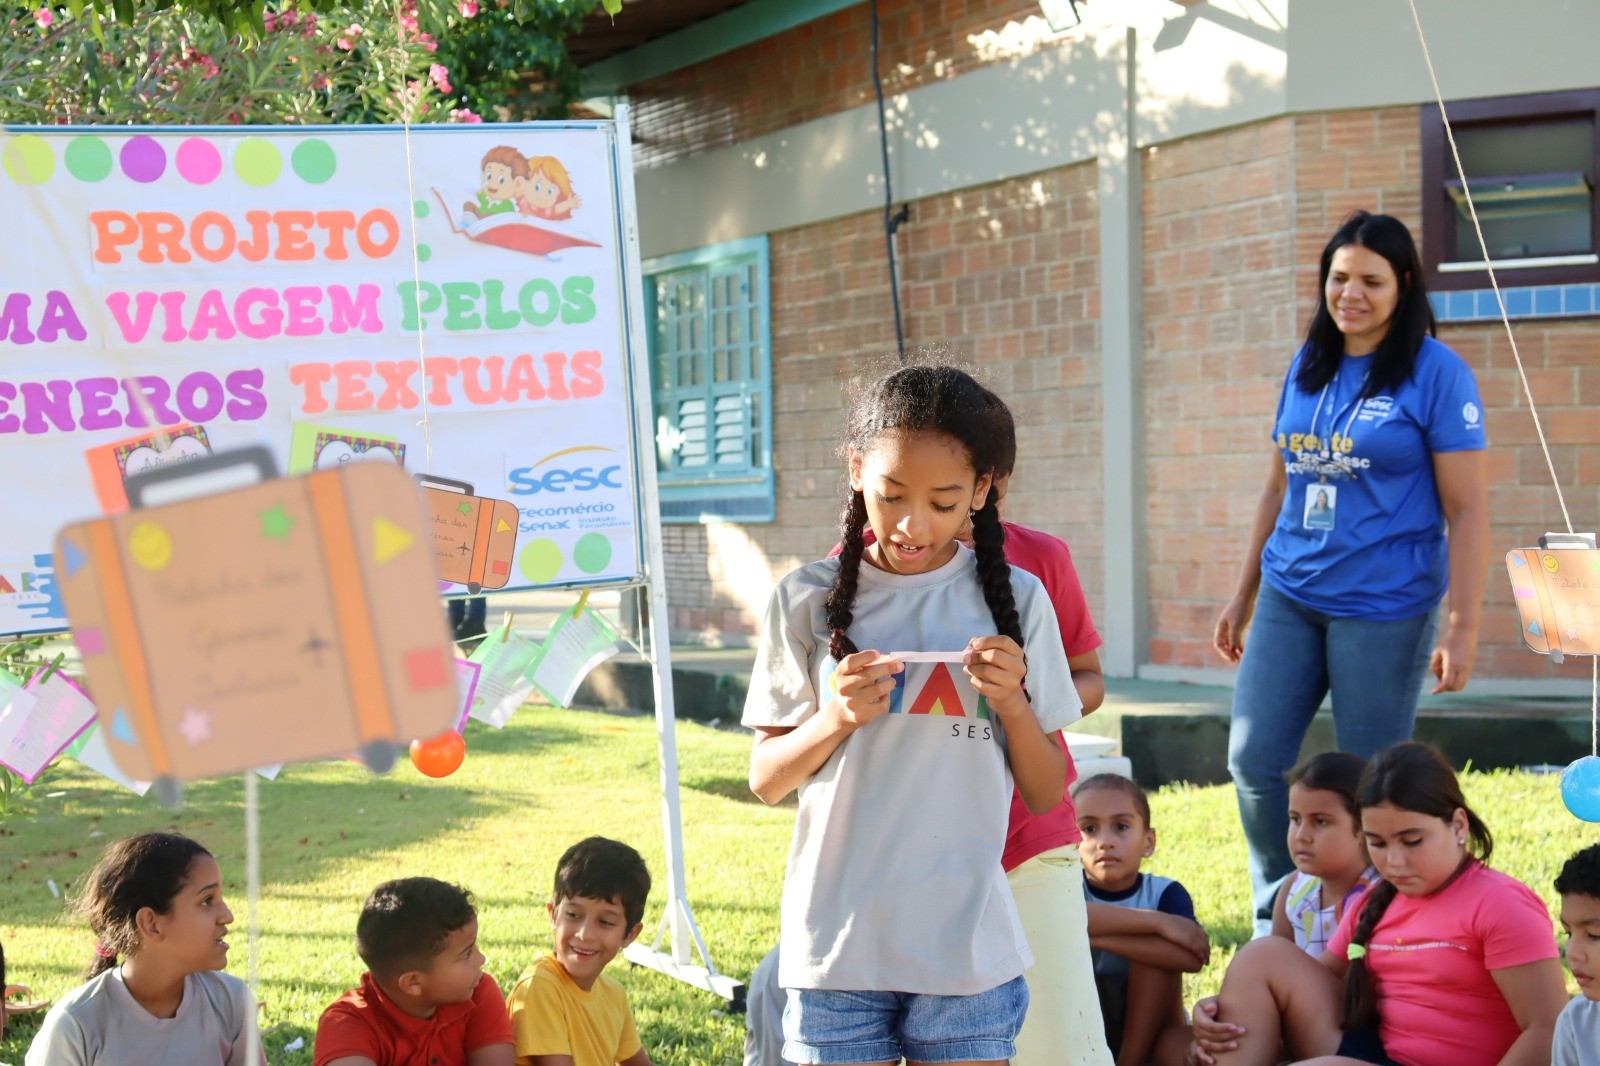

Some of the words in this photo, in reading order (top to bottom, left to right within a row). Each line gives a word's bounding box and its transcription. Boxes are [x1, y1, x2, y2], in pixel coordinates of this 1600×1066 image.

[106, 284, 384, 343] VIAGEM
[398, 276, 597, 331] PELOS
[290, 350, 604, 413] TEXTUAIS
[1289, 432, 1354, 454] gete
